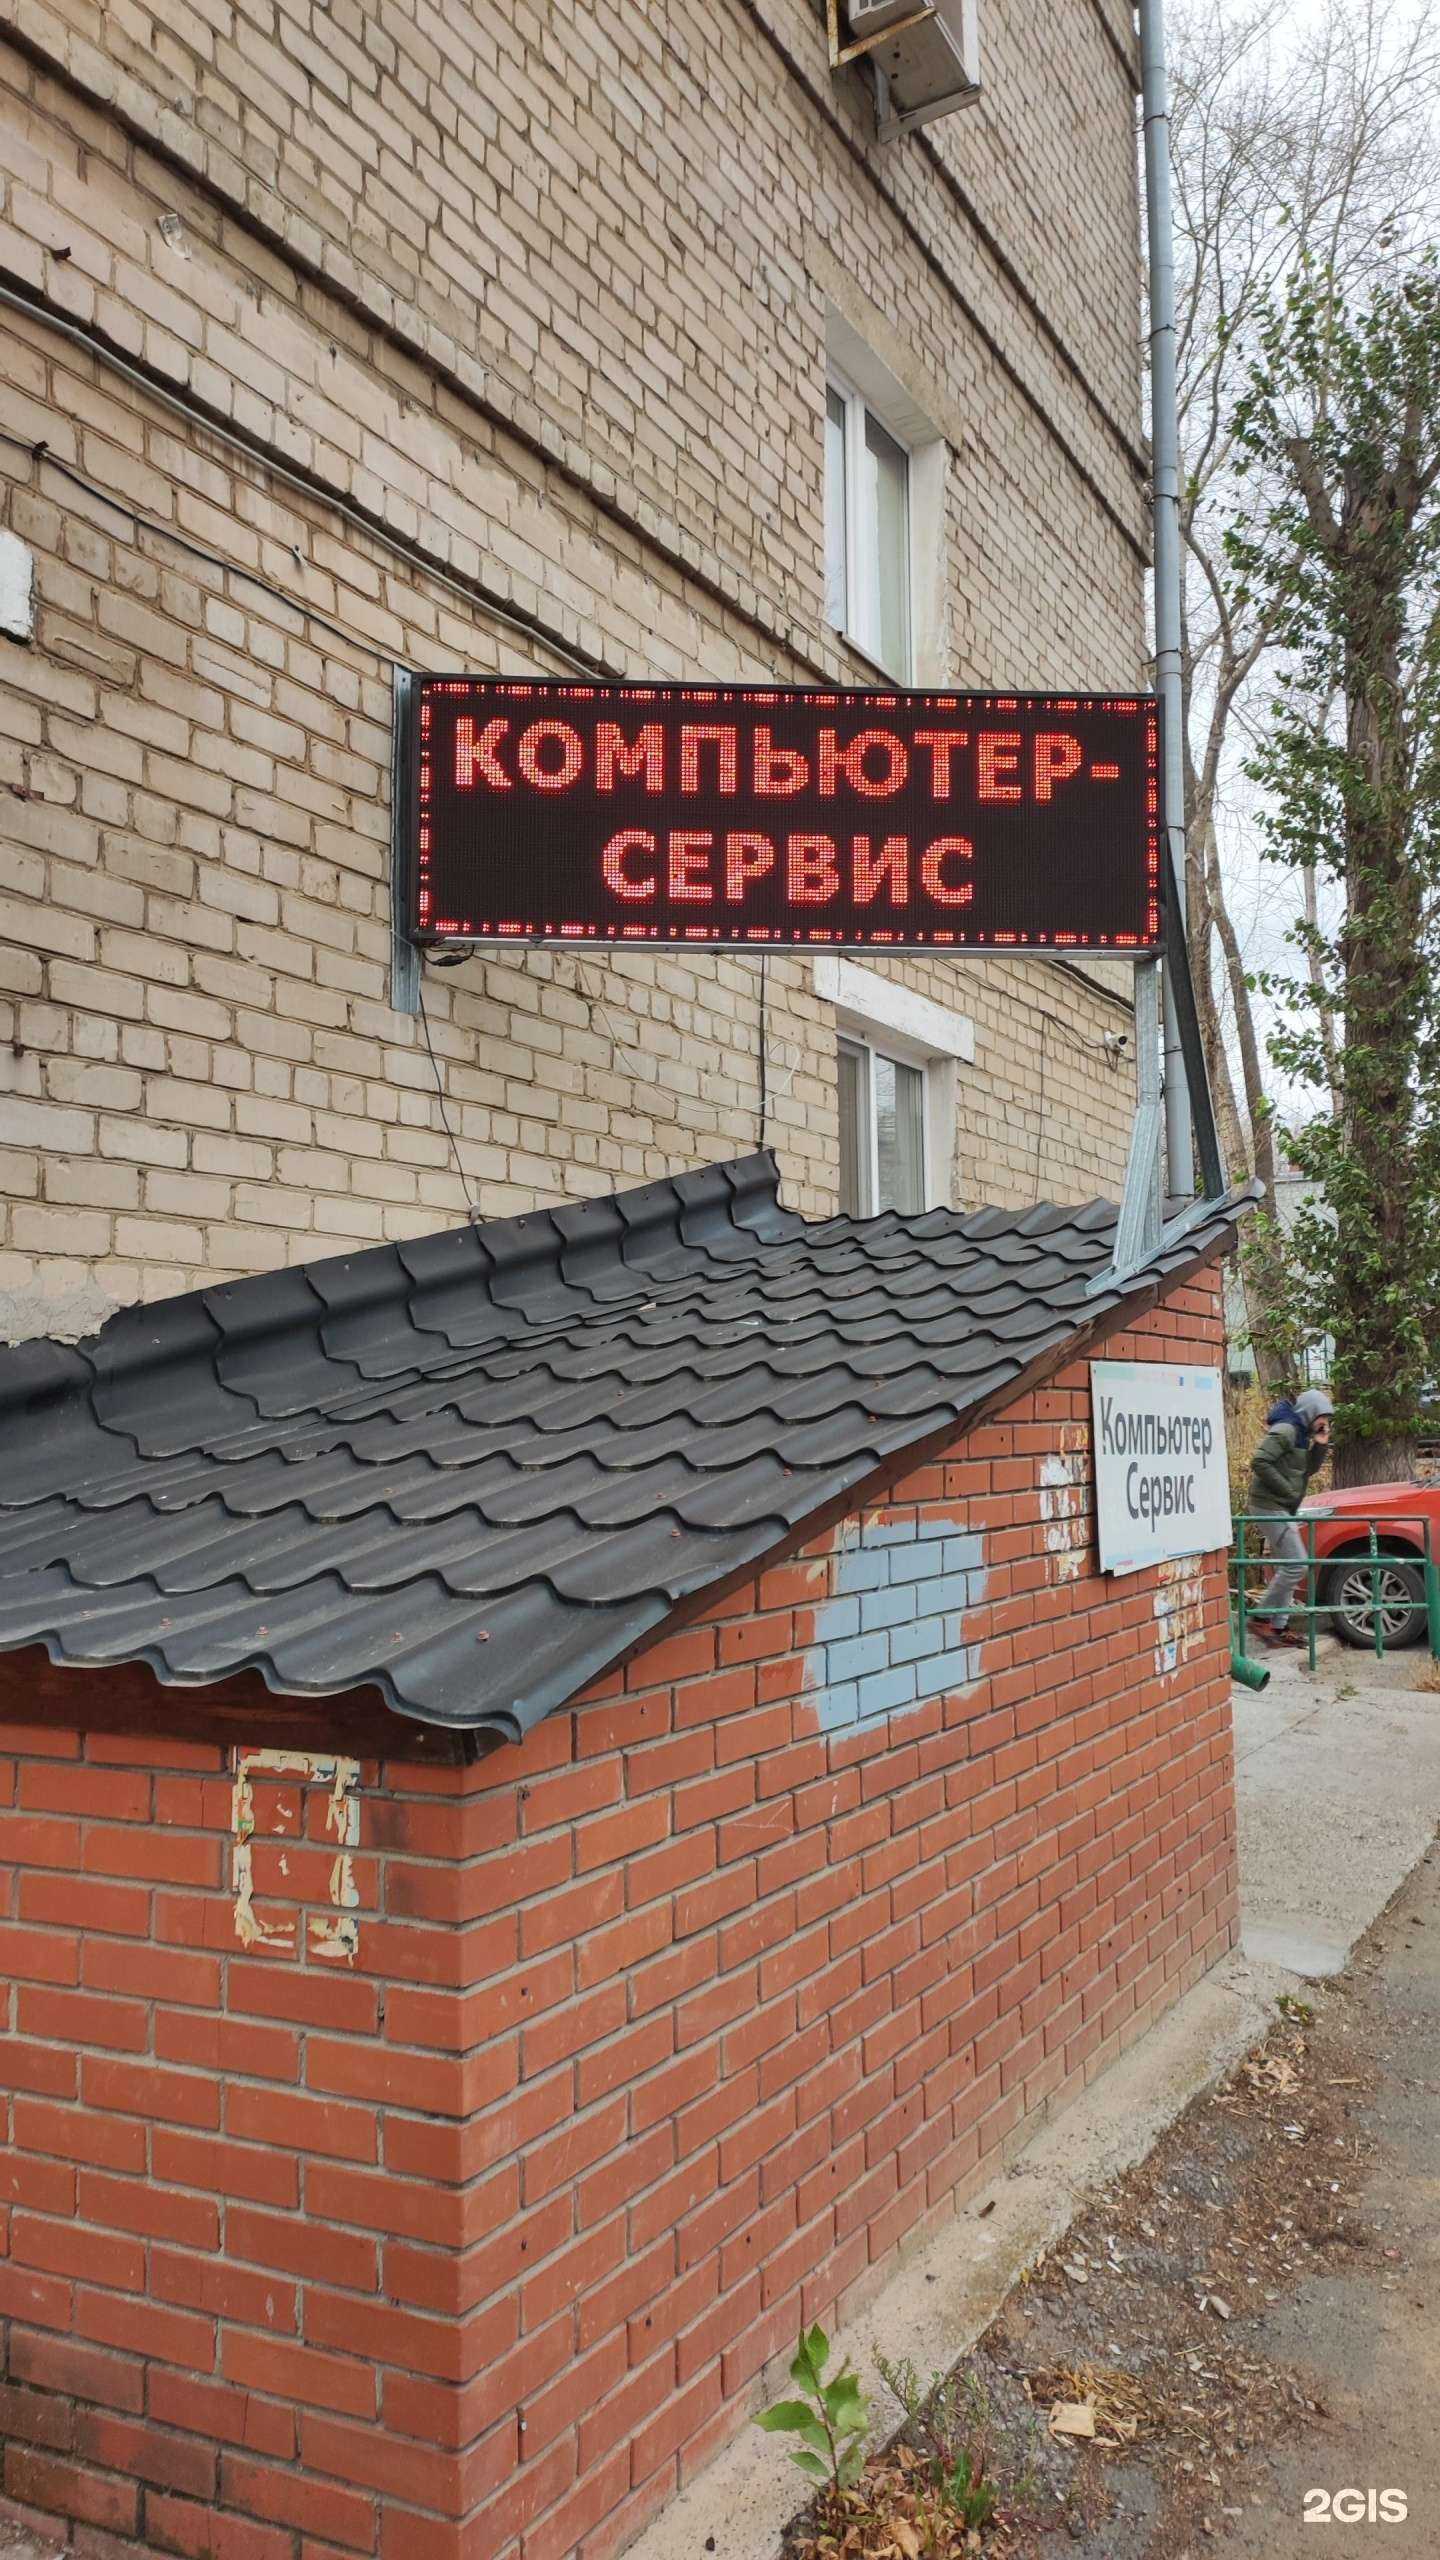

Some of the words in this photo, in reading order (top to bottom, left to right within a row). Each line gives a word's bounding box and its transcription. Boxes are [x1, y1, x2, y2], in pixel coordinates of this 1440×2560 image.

[454, 714, 1121, 803] КОМПЬЮТЕР-
[601, 829, 975, 906] СЕРВИС
[1100, 1396, 1213, 1469] Компьютер
[1126, 1461, 1196, 1533] Сервис
